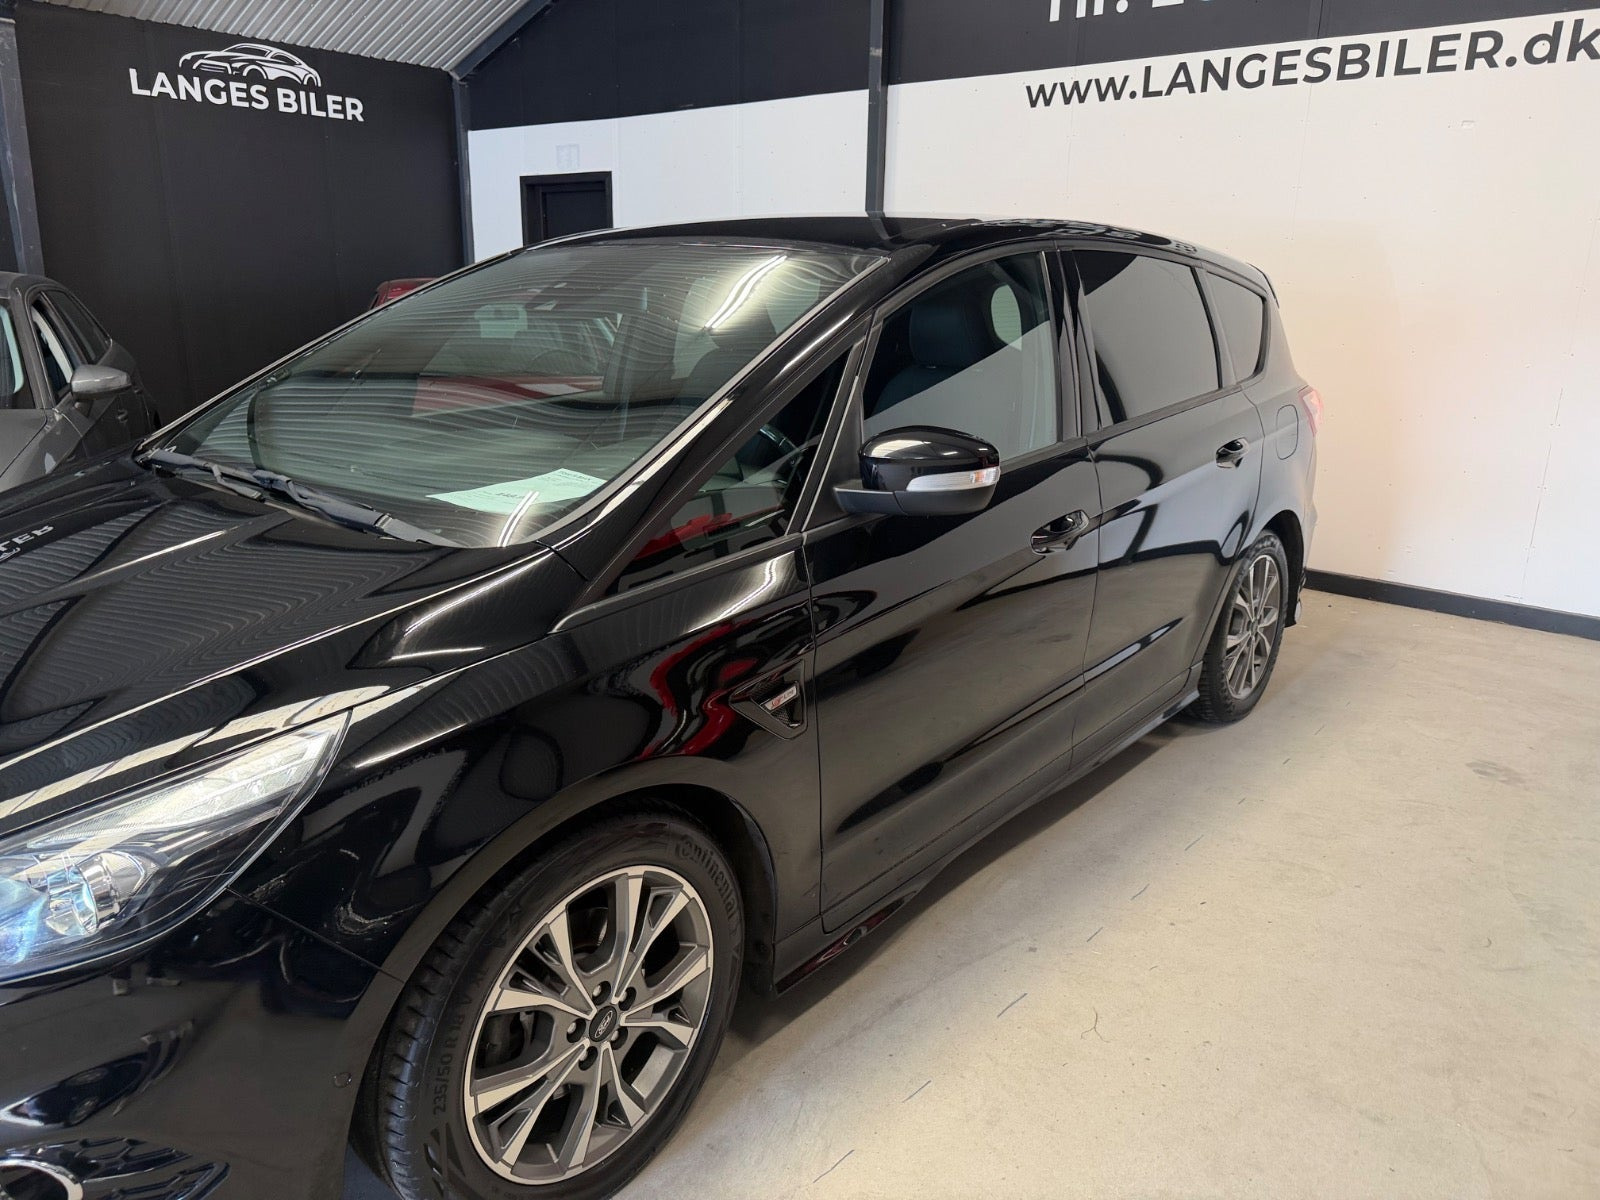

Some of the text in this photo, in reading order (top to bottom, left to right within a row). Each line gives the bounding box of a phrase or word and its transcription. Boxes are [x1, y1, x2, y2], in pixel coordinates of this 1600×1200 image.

[128, 67, 365, 123] LANGES BILER
[1025, 19, 1600, 109] www.LANGESBILER.dk
[674, 834, 739, 922] Continental
[433, 1053, 454, 1115] 235/50
